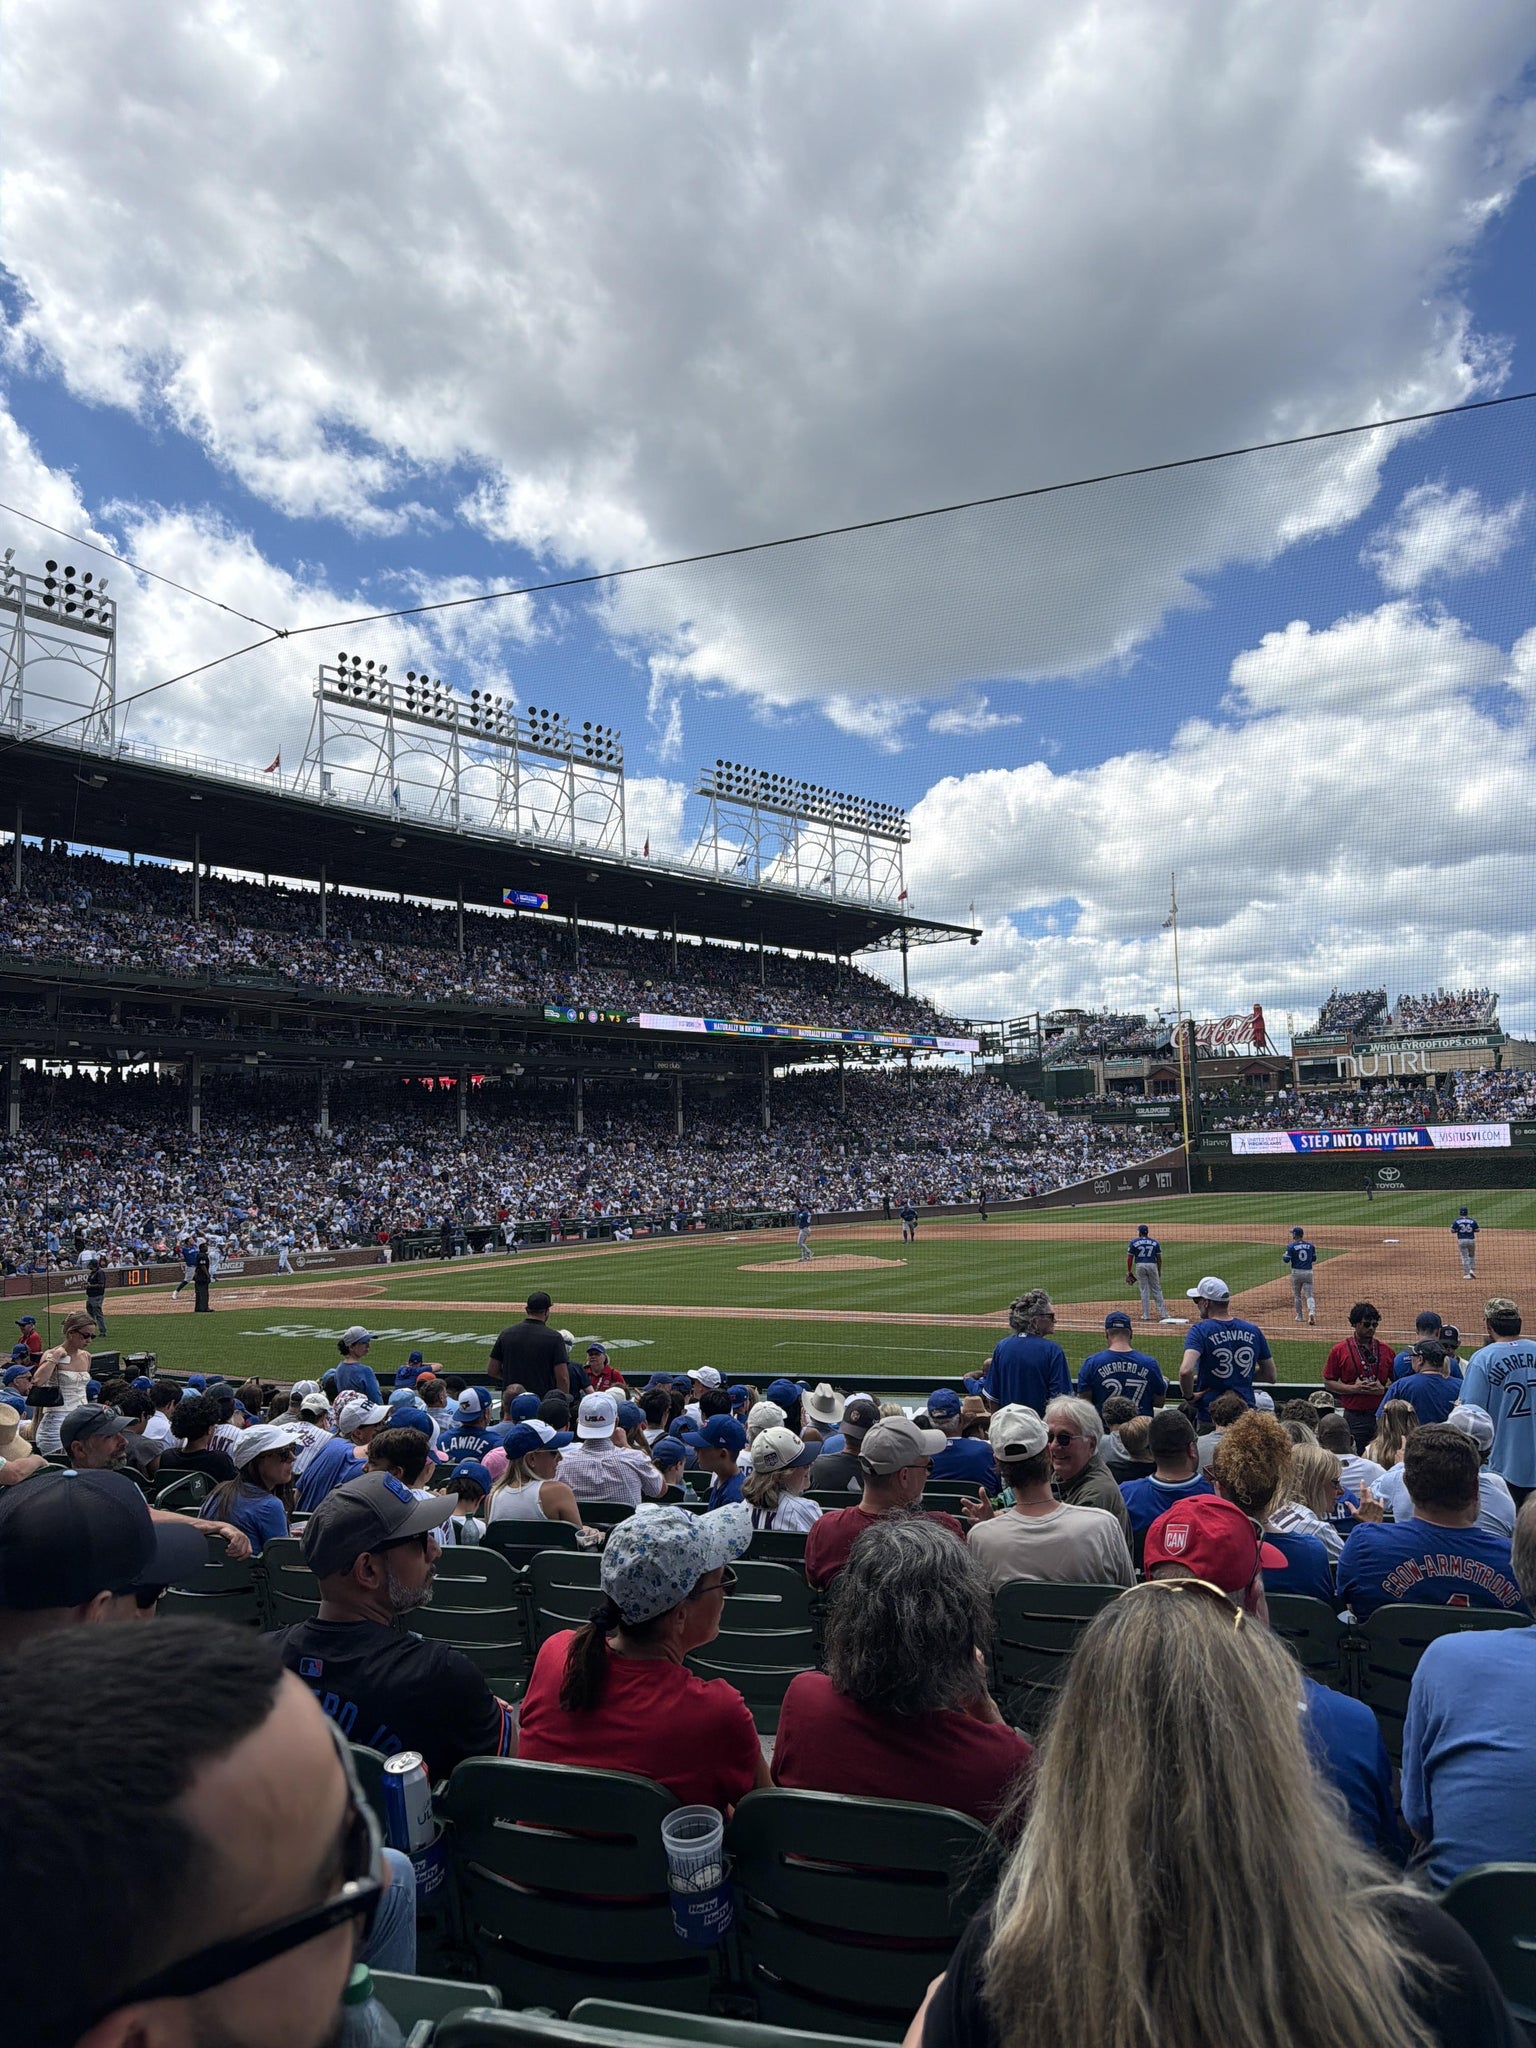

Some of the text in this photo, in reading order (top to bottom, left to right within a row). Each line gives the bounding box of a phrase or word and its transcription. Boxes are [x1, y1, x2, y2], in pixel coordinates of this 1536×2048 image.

[579, 1011, 621, 1023] 0 3 5
[713, 1022, 763, 1034] NATURALLY IN RHYTHM
[1370, 1037, 1488, 1052] WRIGLEYROOFTOPS.COM
[1202, 1138, 1229, 1147] Harvey
[1301, 1131, 1419, 1148] STEP INTO RHYTHM
[1440, 1130, 1500, 1142] VISITUSVI.COM
[1093, 1180, 1111, 1194] eero
[1155, 1172, 1172, 1188] YETI
[1458, 1223, 1473, 1233] 36
[1137, 1245, 1154, 1258] 27
[1298, 1249, 1308, 1262] 0
[1208, 1329, 1256, 1346] YESAVAGE
[1098, 1362, 1137, 1378] GUERRERO
[1210, 1346, 1255, 1379] 39
[1488, 1352, 1536, 1387] GUERRER
[1101, 1378, 1149, 1406] 27
[440, 1435, 490, 1454] LAWRIE
[1166, 1532, 1185, 1548] CAN
[1381, 1553, 1522, 1608] CROW-ARMSTRONG
[688, 1897, 719, 1914] Hefty
